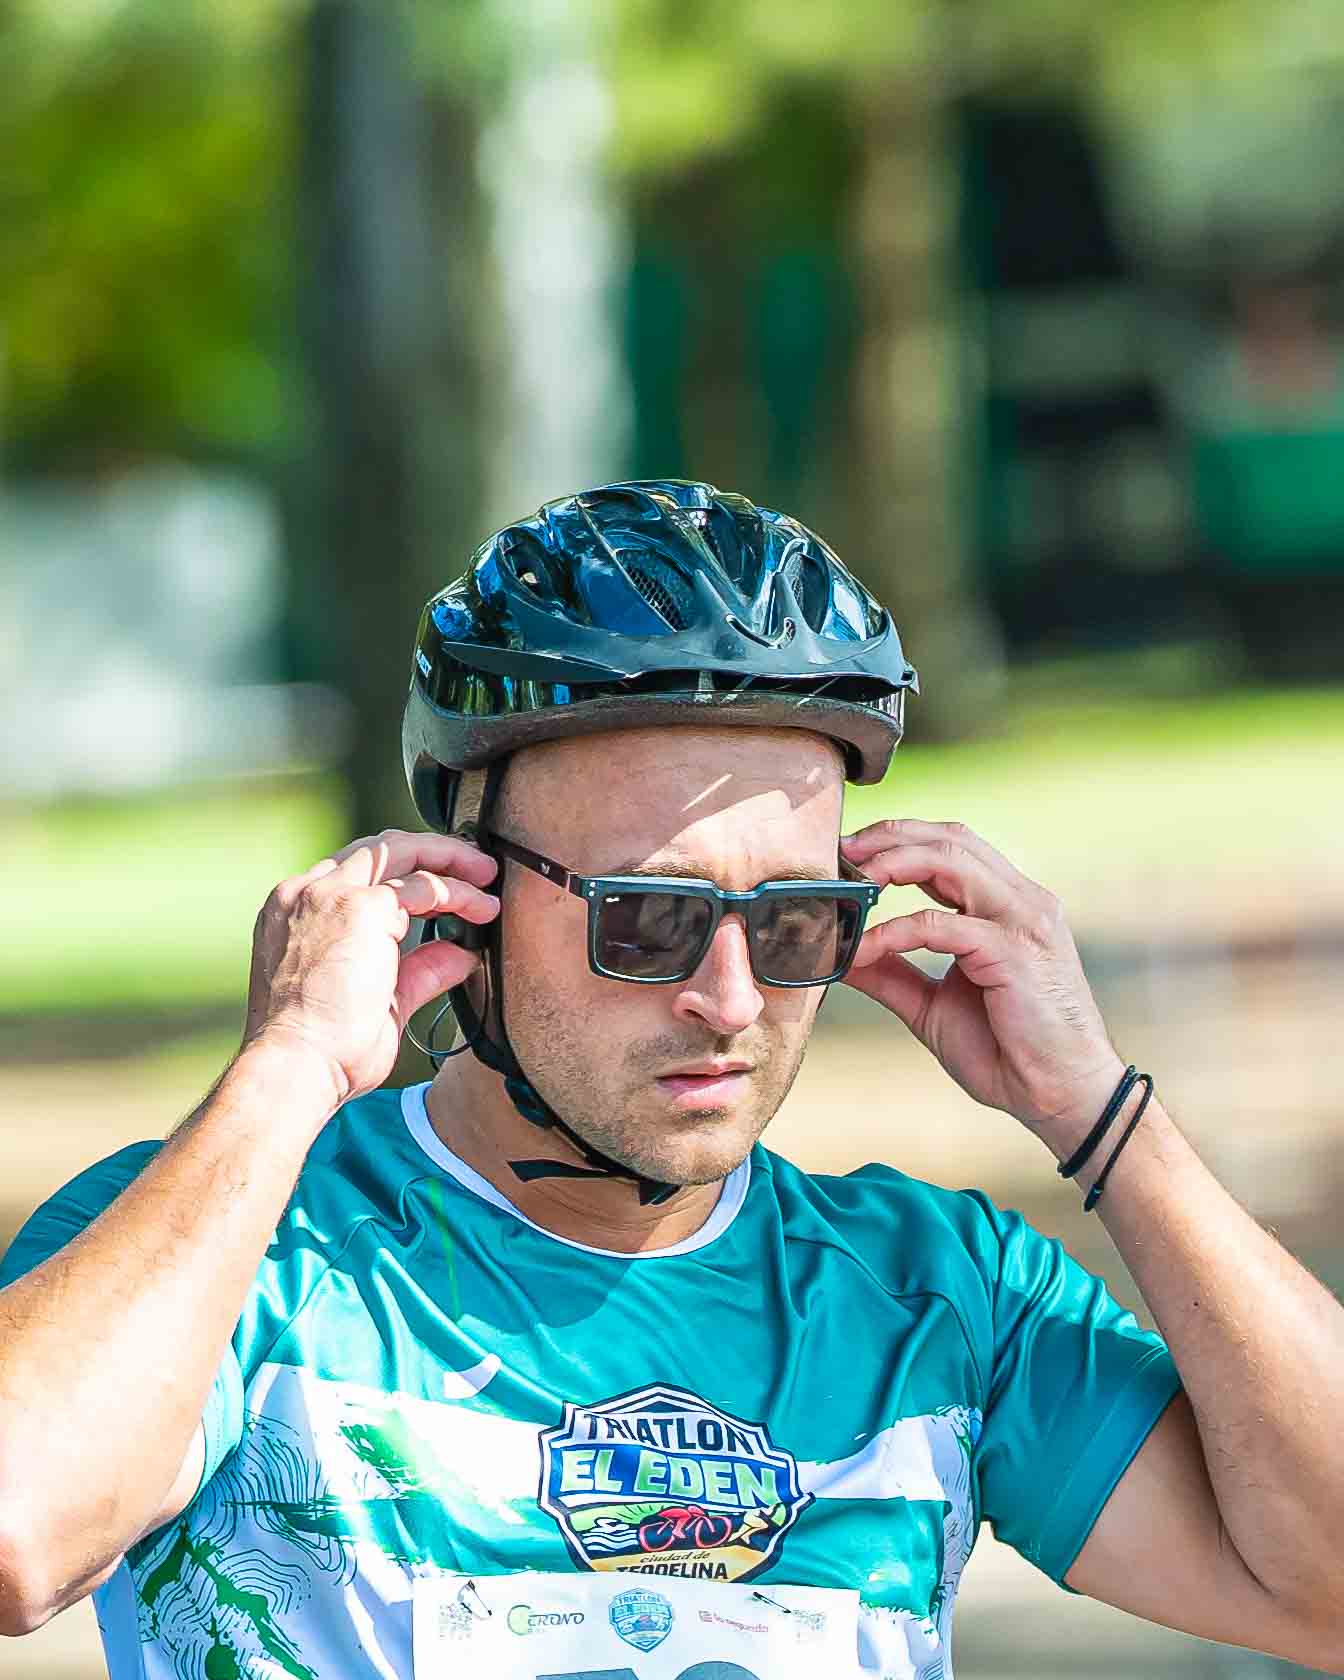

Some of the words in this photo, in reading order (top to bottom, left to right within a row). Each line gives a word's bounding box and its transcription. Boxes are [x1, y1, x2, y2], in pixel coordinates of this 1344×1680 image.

[583, 1413, 754, 1455] TRIATLON
[559, 1448, 623, 1493] EL
[633, 1451, 779, 1508] EDEN
[639, 1552, 690, 1564] ciudad
[692, 1549, 712, 1560] de
